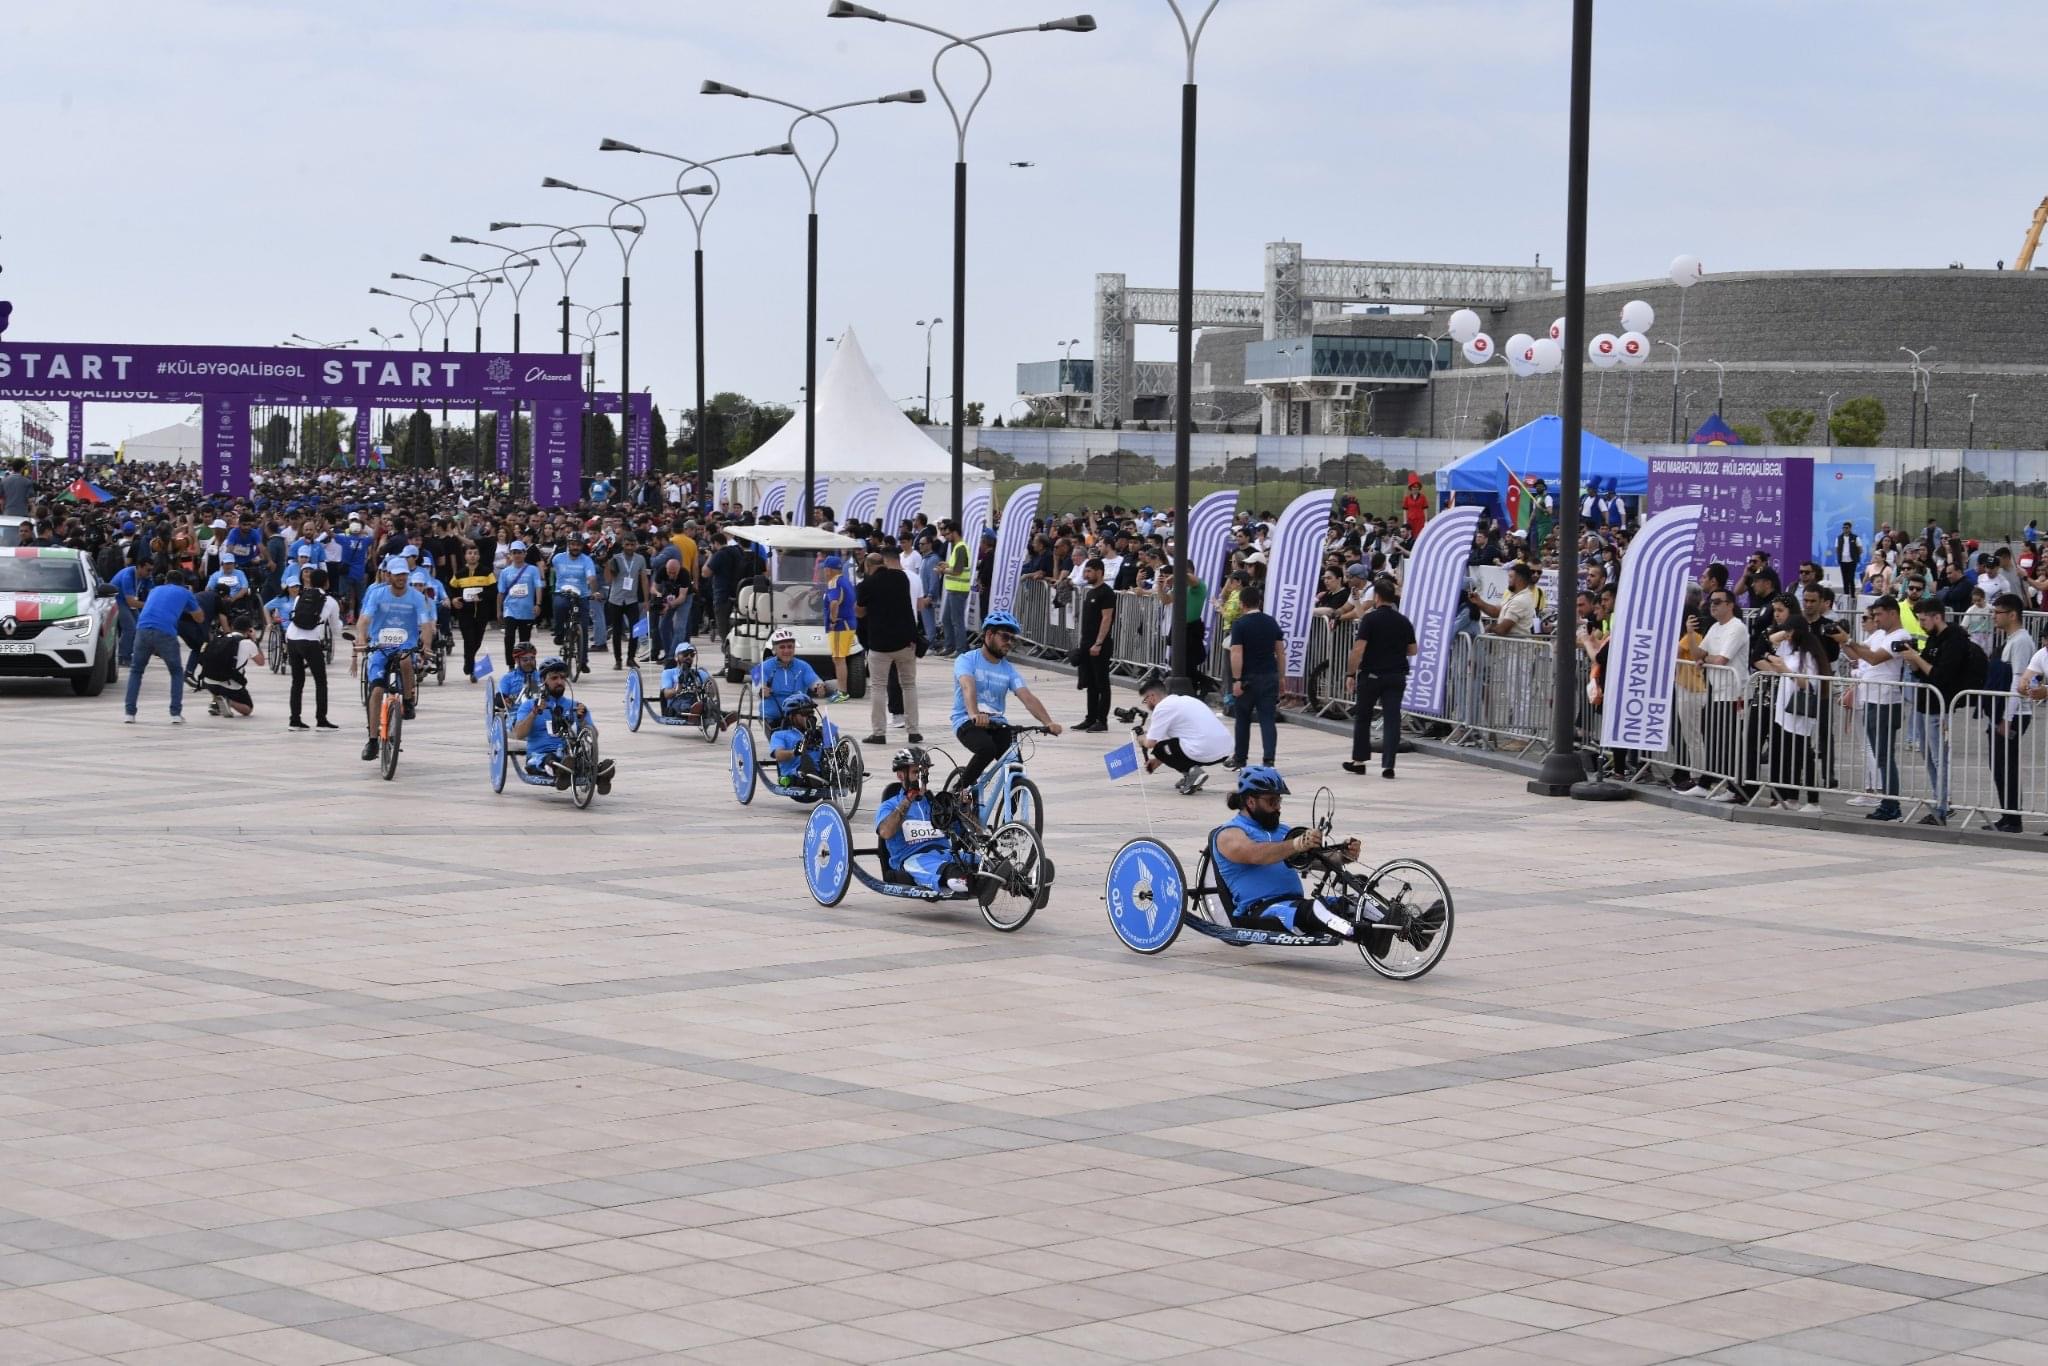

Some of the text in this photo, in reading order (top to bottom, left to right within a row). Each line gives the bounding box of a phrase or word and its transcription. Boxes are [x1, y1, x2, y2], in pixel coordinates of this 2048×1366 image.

[0, 352, 133, 380] START
[323, 360, 461, 387] START
[1703, 461, 1719, 475] 2022
[1288, 640, 1304, 673] BAKI
[1623, 634, 1652, 743] MARAFONU
[1645, 702, 1665, 745] BAKI
[911, 828, 937, 838] 8012
[1235, 930, 1251, 940] TOP
[1252, 931, 1268, 942] END
